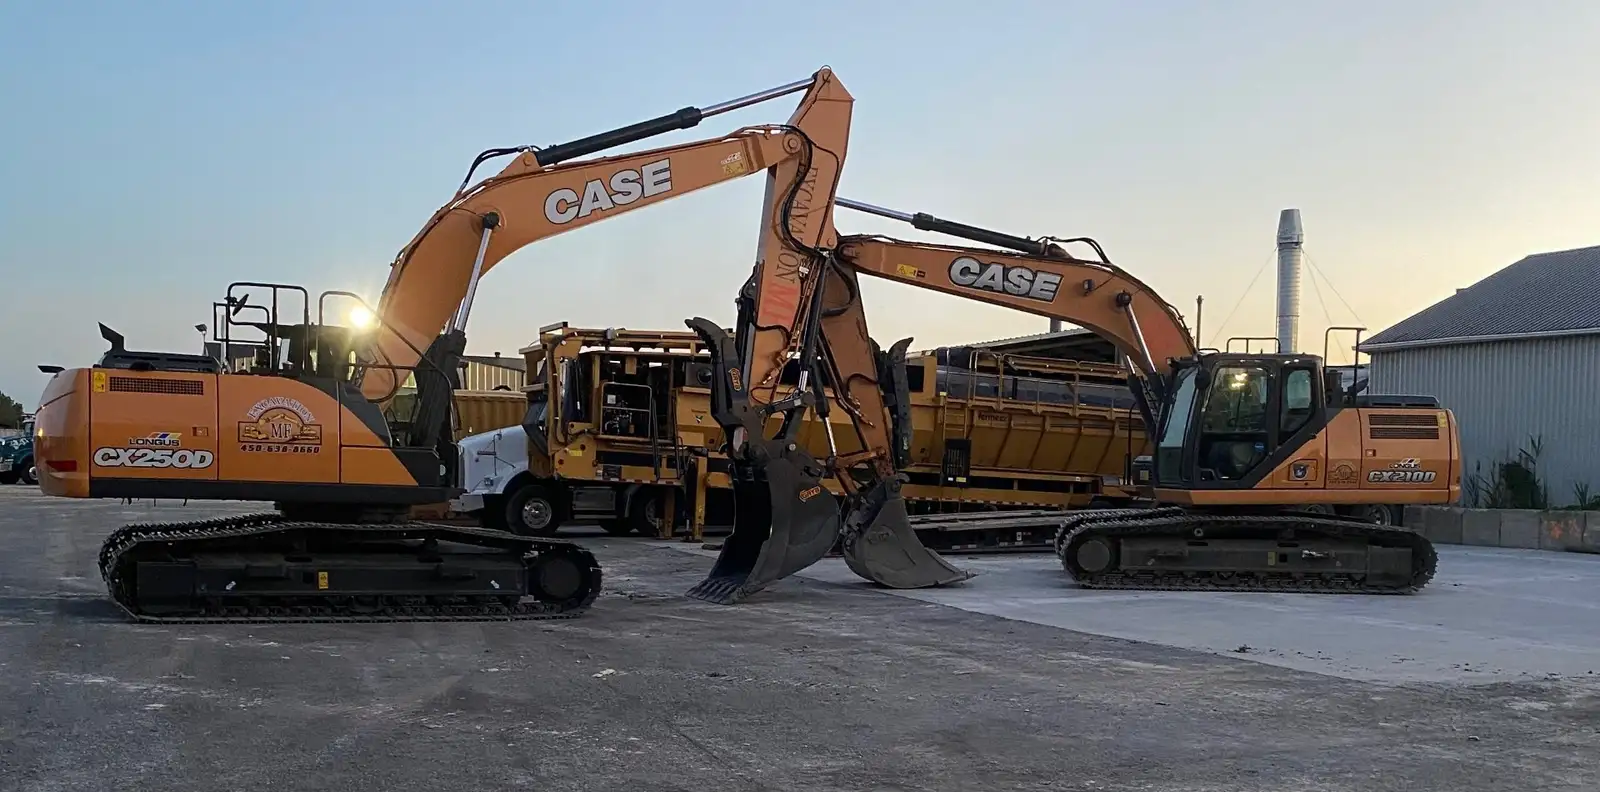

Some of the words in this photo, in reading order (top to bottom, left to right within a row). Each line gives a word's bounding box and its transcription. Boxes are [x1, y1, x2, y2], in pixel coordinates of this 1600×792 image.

[544, 158, 673, 225] CASE
[774, 167, 819, 284] EXCAVAON
[949, 257, 1063, 303] CASE
[247, 396, 316, 424] EXCAVATION
[129, 438, 180, 447] LONGUS
[271, 423, 293, 438] MF
[93, 447, 215, 469] CX250D
[1367, 470, 1437, 483] CX210D
